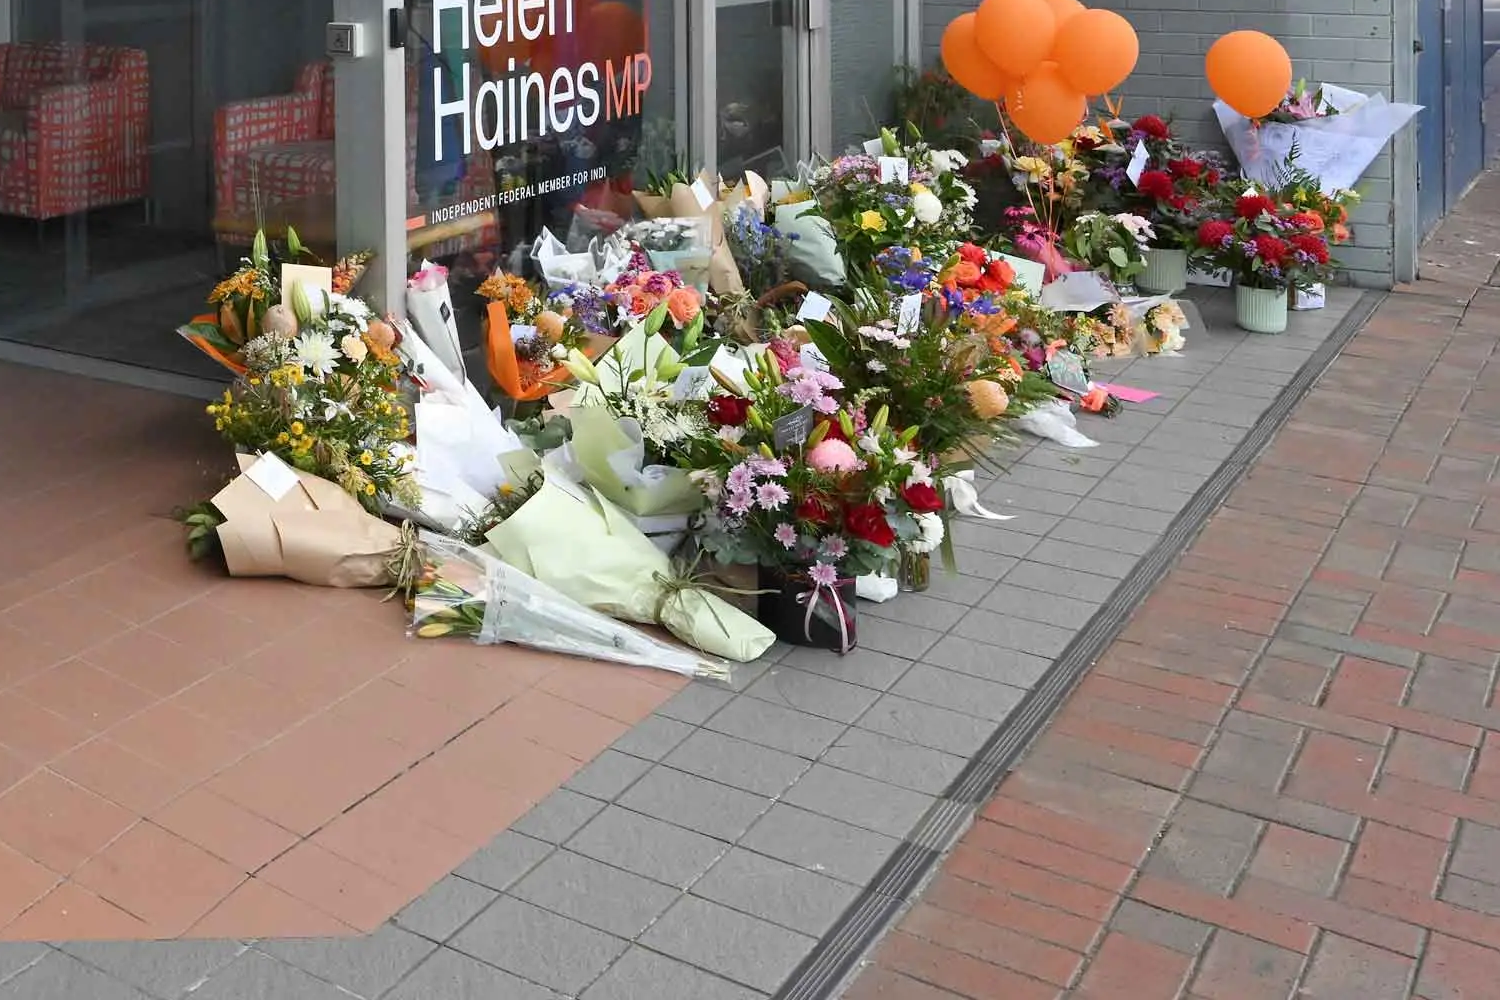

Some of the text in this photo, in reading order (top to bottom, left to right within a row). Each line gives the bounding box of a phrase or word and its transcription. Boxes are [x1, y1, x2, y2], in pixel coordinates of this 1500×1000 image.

[433, 52, 652, 162] Haines MP
[431, 165, 607, 225] INDEPENDENT FEDERAL MEMBER FOR INDI
